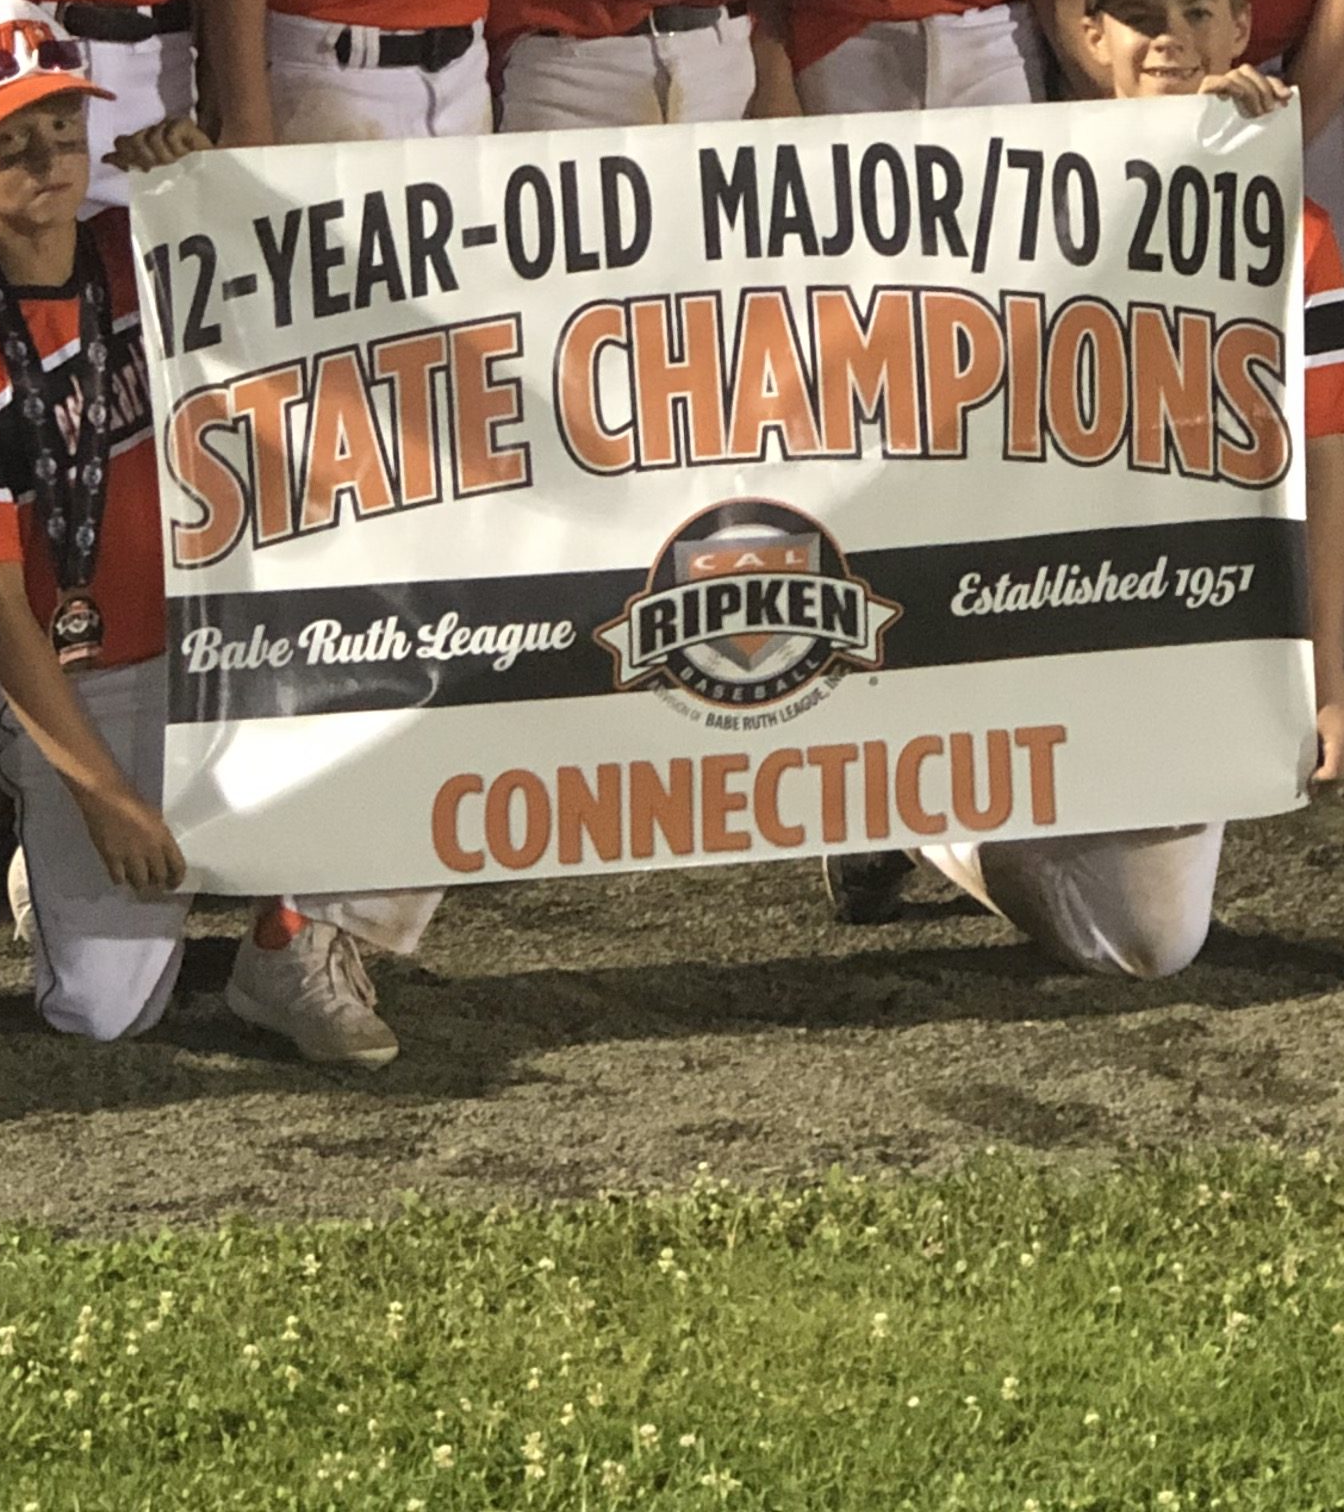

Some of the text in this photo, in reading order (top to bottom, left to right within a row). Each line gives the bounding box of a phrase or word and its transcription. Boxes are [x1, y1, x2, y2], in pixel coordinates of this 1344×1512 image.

[143, 137, 1287, 359] 12-YEAR-OLD MAJOR/70 2019
[163, 311, 534, 571] STATE
[552, 285, 1295, 490] CHAMPIONS
[693, 549, 805, 571] CAL
[950, 555, 1255, 617] Established 1951
[182, 611, 576, 674] Babe Ruth League
[639, 579, 858, 657] RIPKEN
[679, 659, 820, 702] BASEBALL
[706, 711, 740, 731] BABE
[742, 711, 778, 731] RUTH
[430, 724, 1069, 874] CONNECTICUT
